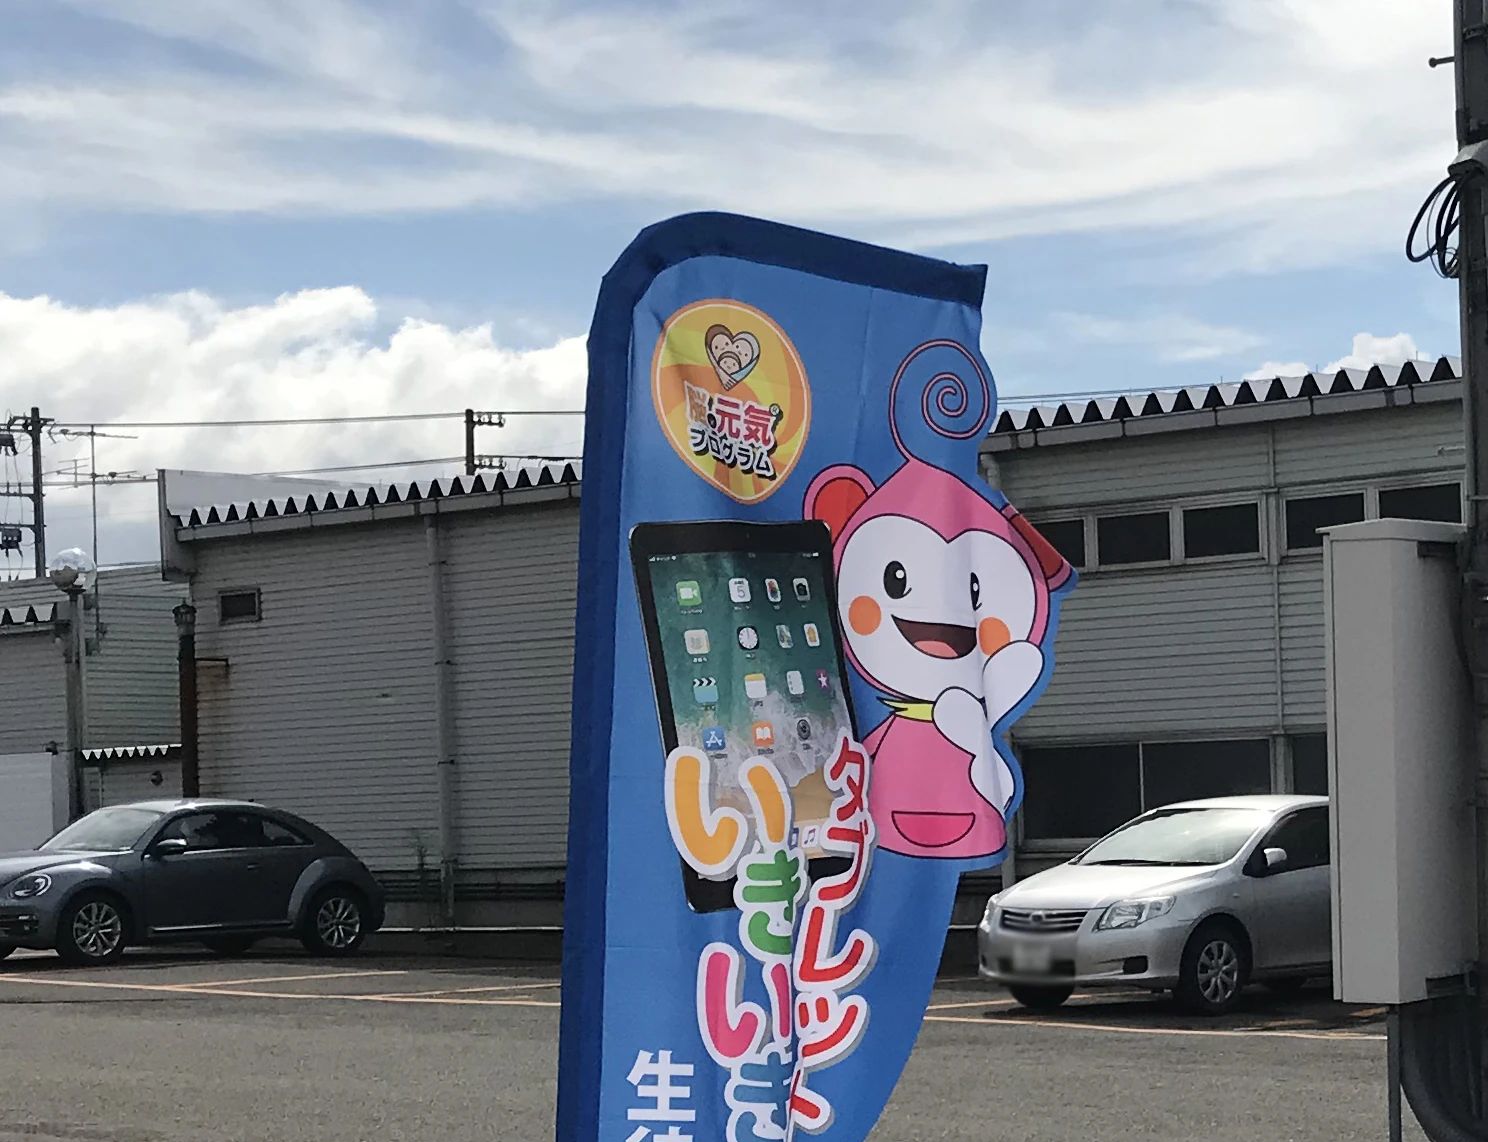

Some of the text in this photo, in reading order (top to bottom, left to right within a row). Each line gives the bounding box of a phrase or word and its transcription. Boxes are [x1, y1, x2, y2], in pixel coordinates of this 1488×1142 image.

[690, 427, 772, 474] プログラム
